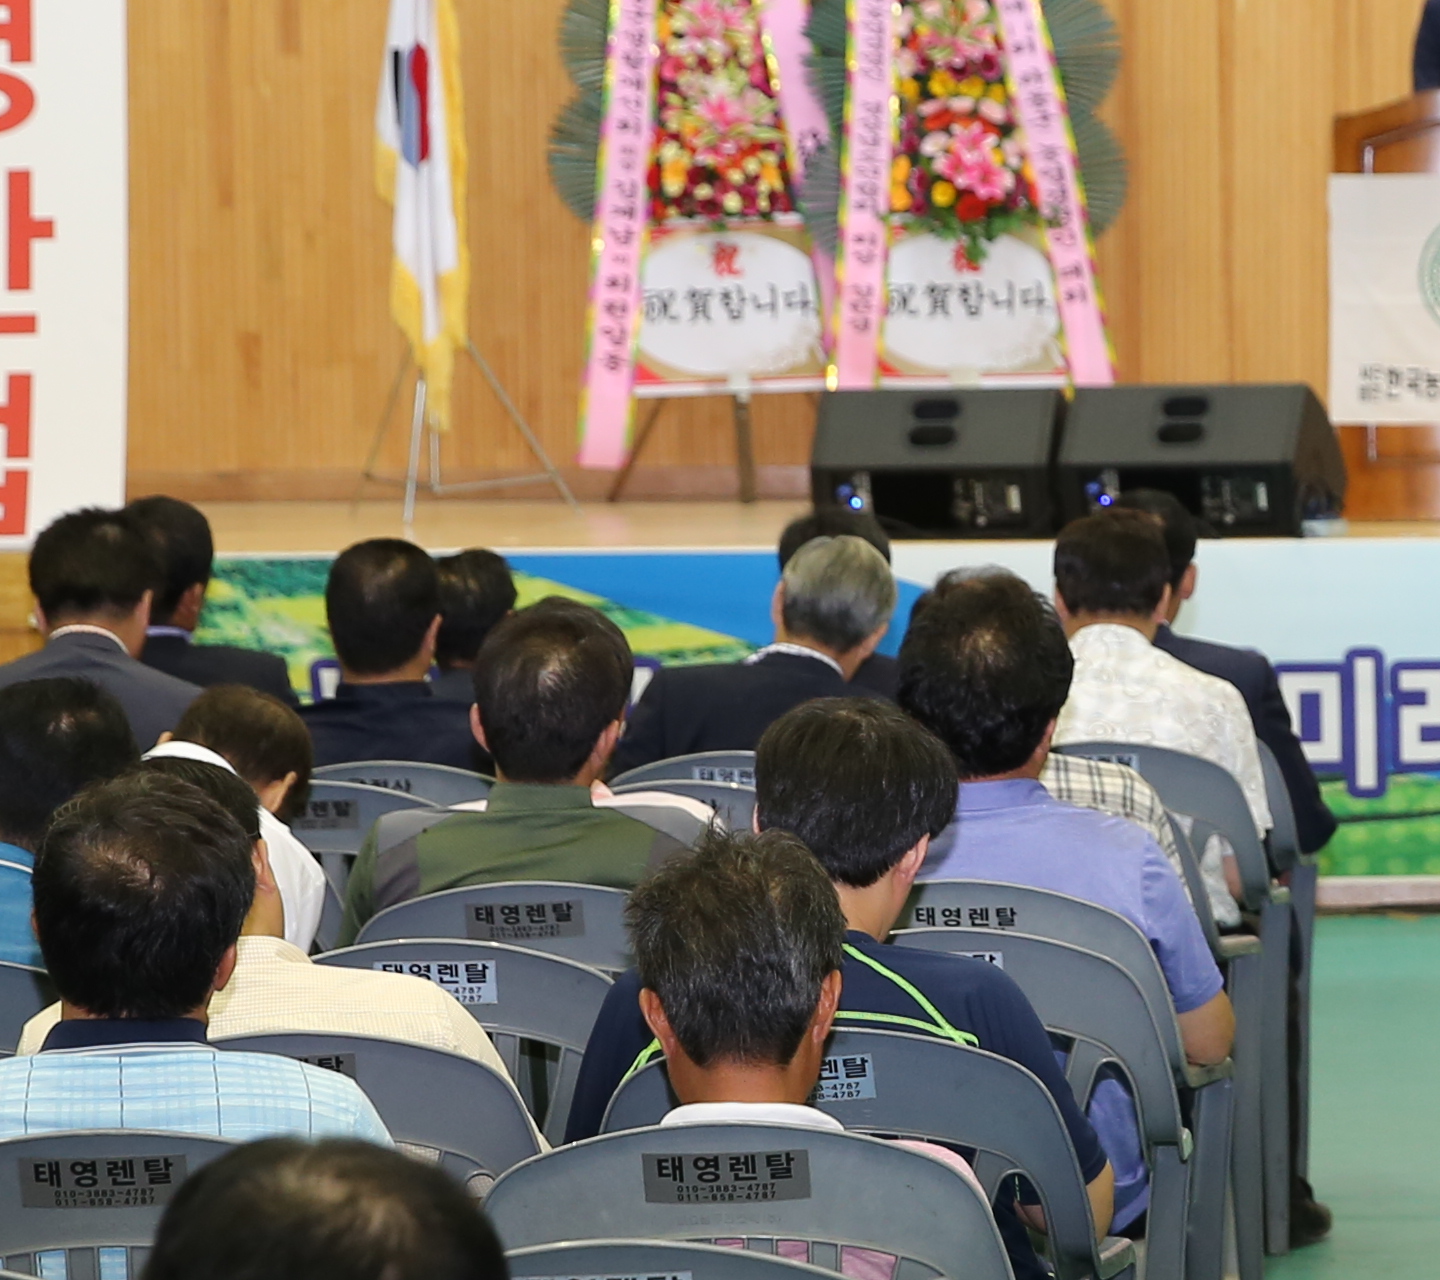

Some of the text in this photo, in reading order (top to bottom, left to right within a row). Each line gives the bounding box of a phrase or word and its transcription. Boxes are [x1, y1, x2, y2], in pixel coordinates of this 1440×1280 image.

[473, 901, 574, 925] 태영렌탈
[914, 904, 1020, 928] 태영렌탈
[31, 1156, 176, 1189] 태영렌탈
[656, 1151, 796, 1184] 태영렌탈
